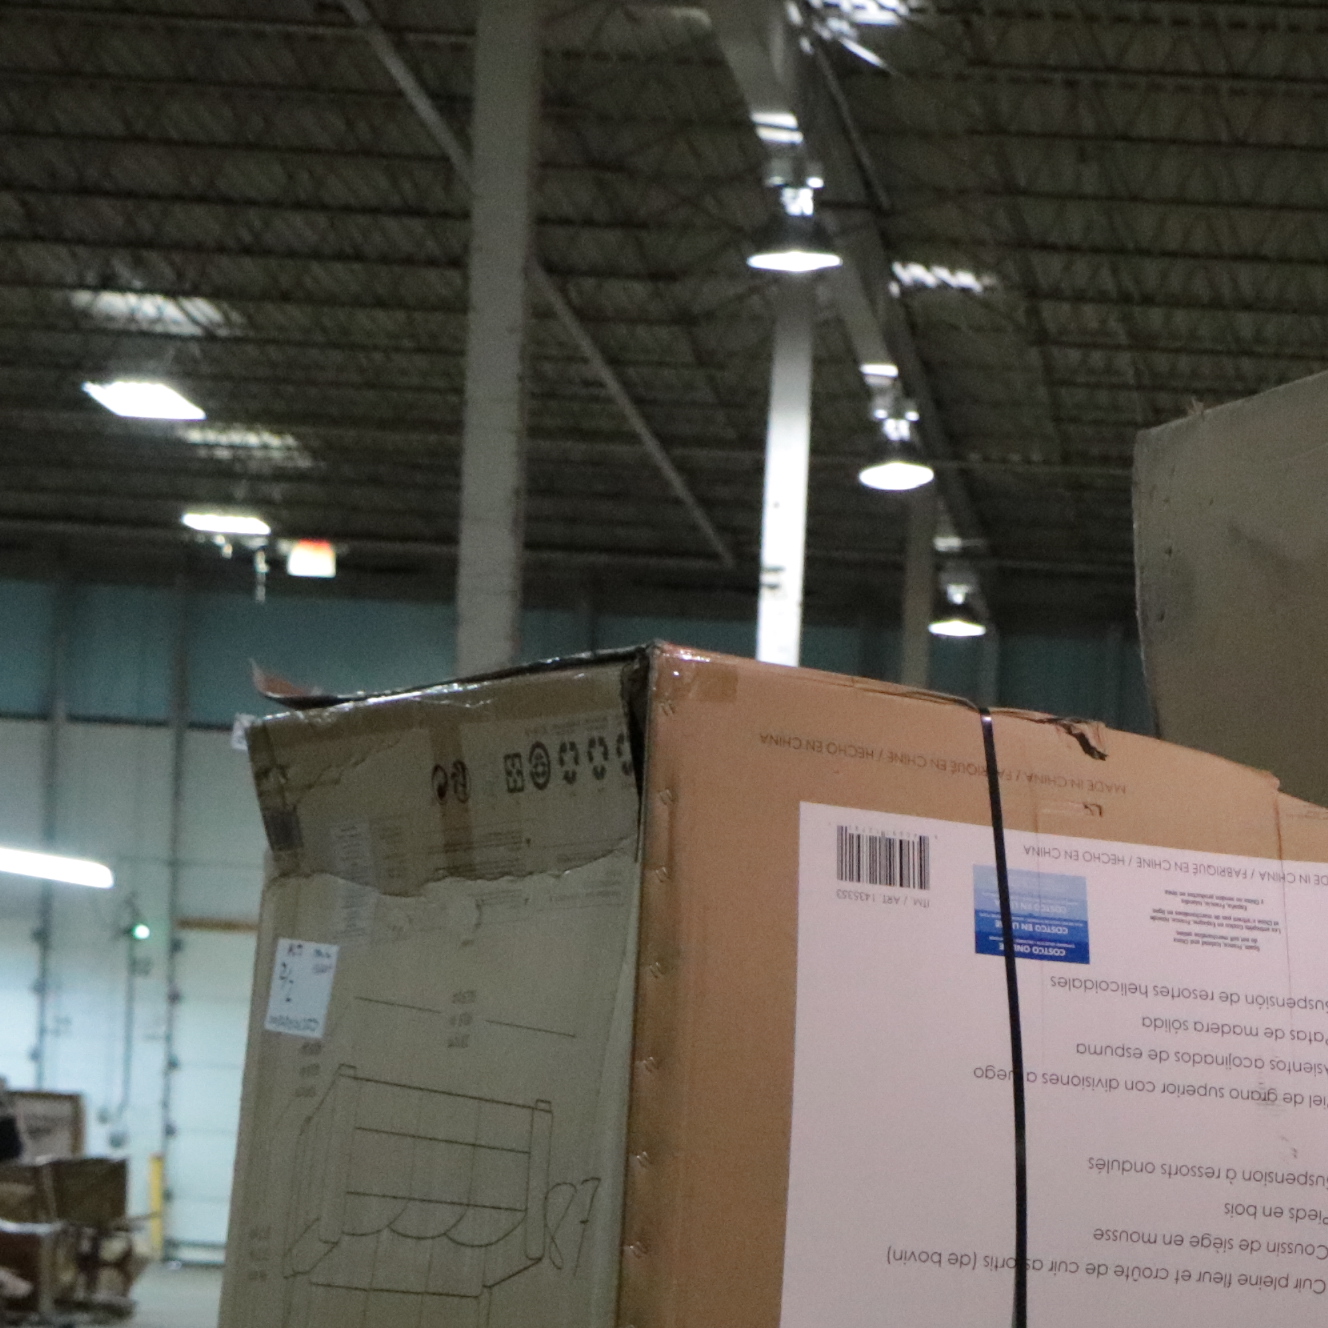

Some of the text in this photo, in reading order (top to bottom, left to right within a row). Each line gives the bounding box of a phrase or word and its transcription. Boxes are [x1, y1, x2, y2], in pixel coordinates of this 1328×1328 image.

[759, 733, 802, 750] CHINA
[806, 740, 822, 752] EN
[826, 742, 873, 758] HECHO
[887, 750, 927, 769] CHINE
[930, 759, 947, 772] EN
[950, 761, 1012, 781] FARIQUÉ
[1024, 771, 1067, 788] CHINA
[1070, 779, 1084, 790] IN
[1088, 782, 1125, 795] MADE
[1023, 845, 1061, 860] CHINA
[1064, 850, 1079, 861] EN
[1082, 850, 1125, 865] HECHO
[1136, 857, 1171, 871] CHINE
[1174, 861, 1189, 873] EN
[1192, 862, 1247, 878] FABRIQUÉ
[1259, 870, 1295, 883] CHINA
[1299, 873, 1310, 883] IN
[836, 889, 875, 902] 1435353
[880, 894, 900, 904] ART.
[912, 898, 929, 908] ITM.
[1021, 923, 1033, 931] EN
[1035, 925, 1068, 934] COSTCO
[999, 942, 1065, 956] COSTCO ONLE
[1050, 975, 1148, 1000] helicoidales
[1153, 984, 1214, 1006] resortes
[1220, 991, 1240, 1008] de
[1142, 1016, 1189, 1036] sólida
[1195, 1021, 1258, 1039] madera
[1264, 1026, 1285, 1042] de
[1076, 1042, 1139, 1064] espuma
[1144, 1050, 1168, 1067] de
[1174, 1049, 1264, 1072] acojinados
[1026, 1072, 1037, 1086] a
[1042, 1073, 1119, 1096] divisiones
[1124, 1079, 1156, 1096] con
[1161, 1079, 1224, 1102] superior
[1229, 1086, 1277, 1105] grano
[1282, 1092, 1303, 1108] de
[1088, 1157, 1155, 1177] ondulés
[1160, 1164, 1221, 1182] ressorts
[1226, 1167, 1237, 1185] à
[1224, 1202, 1257, 1219] bois
[1261, 1205, 1282, 1220] en
[1093, 1229, 1328, 1260] Coussin de siège en mousse
[886, 1247, 942, 1268] bovin)
[947, 1252, 977, 1272] (de
[983, 1255, 1043, 1275] asortis
[1049, 1260, 1080, 1279] cuir
[1085, 1263, 1109, 1280] de
[1174, 1269, 1192, 1286] et
[1197, 1272, 1233, 1290] fleur
[1238, 1270, 1289, 1293] pleine
[1294, 1276, 1326, 1294] Cuir
